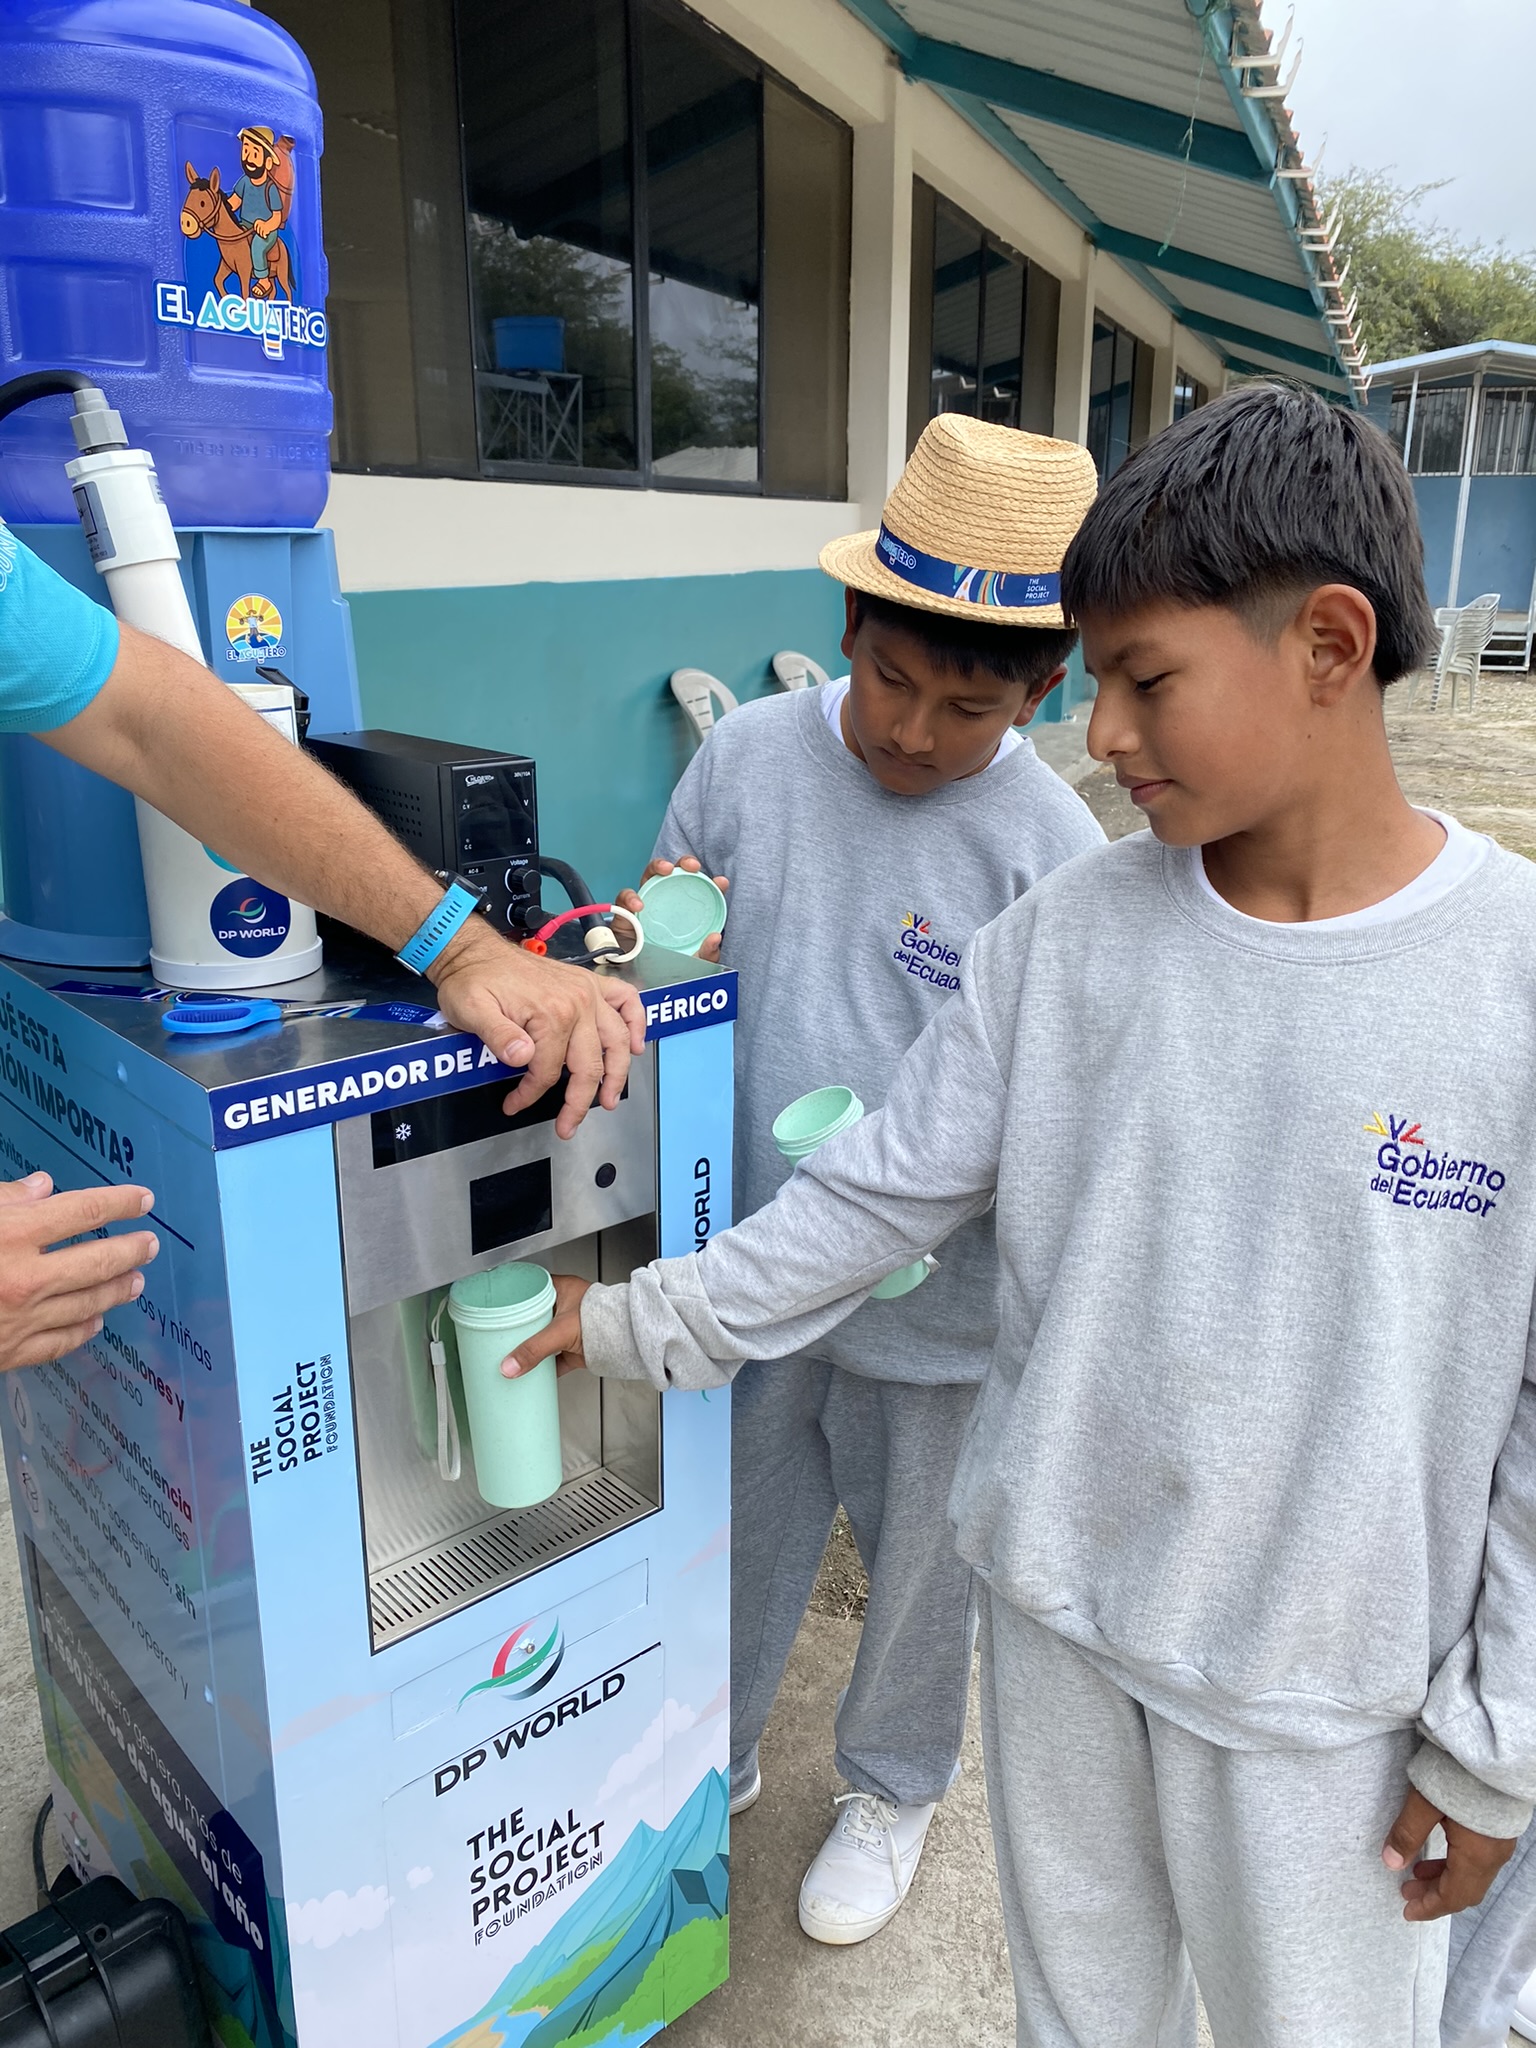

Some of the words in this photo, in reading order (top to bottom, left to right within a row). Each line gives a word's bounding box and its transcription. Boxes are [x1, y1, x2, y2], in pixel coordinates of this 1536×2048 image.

[158, 284, 193, 324] EL
[197, 291, 327, 347] AGUATERO
[1025, 591, 1050, 599] PROJECT
[226, 650, 238, 660] EL
[218, 930, 238, 939] DP
[239, 926, 287, 939] WORLD
[893, 950, 911, 963] del
[907, 955, 961, 990] Ecuad
[0, 991, 19, 1039] UÉ
[18, 1009, 67, 1075] ESTA
[224, 1059, 429, 1130] GENERADOR
[435, 1048, 473, 1078] DE
[646, 988, 728, 1027] FÉRICO
[0, 1042, 32, 1101] IÓN
[32, 1071, 134, 1178] IMPORTA?
[1370, 1173, 1394, 1194] del
[1393, 1178, 1496, 1218] Ecuador
[1377, 1142, 1506, 1191] Gobierno
[157, 1308, 167, 1337] y
[170, 1320, 213, 1372] niñas
[119, 1371, 143, 1408] uso
[175, 1393, 185, 1422] y
[296, 1361, 323, 1462] PROJECT
[319, 1354, 339, 1453] FOUNDATION
[250, 1437, 273, 1484] THE
[273, 1385, 298, 1472] SOCIAL
[91, 1400, 192, 1523] autosuficiencia
[114, 1455, 190, 1551] vulnerables
[102, 1523, 132, 1568] cloro
[175, 1583, 197, 1620] sin
[137, 1620, 177, 1682] operar
[434, 1749, 488, 1797] DP
[492, 1673, 626, 1760] WORLD
[133, 1724, 182, 1800] genera
[185, 1795, 218, 1851] más
[221, 1849, 243, 1884] de
[466, 1807, 525, 1861] THE
[150, 1777, 198, 1860] agua
[200, 1850, 220, 1891] al
[222, 1881, 263, 1950] año
[470, 1808, 581, 1894] SOCIAL
[471, 1820, 605, 1927] PROJECT
[474, 1850, 603, 1946] FOUNDATION
